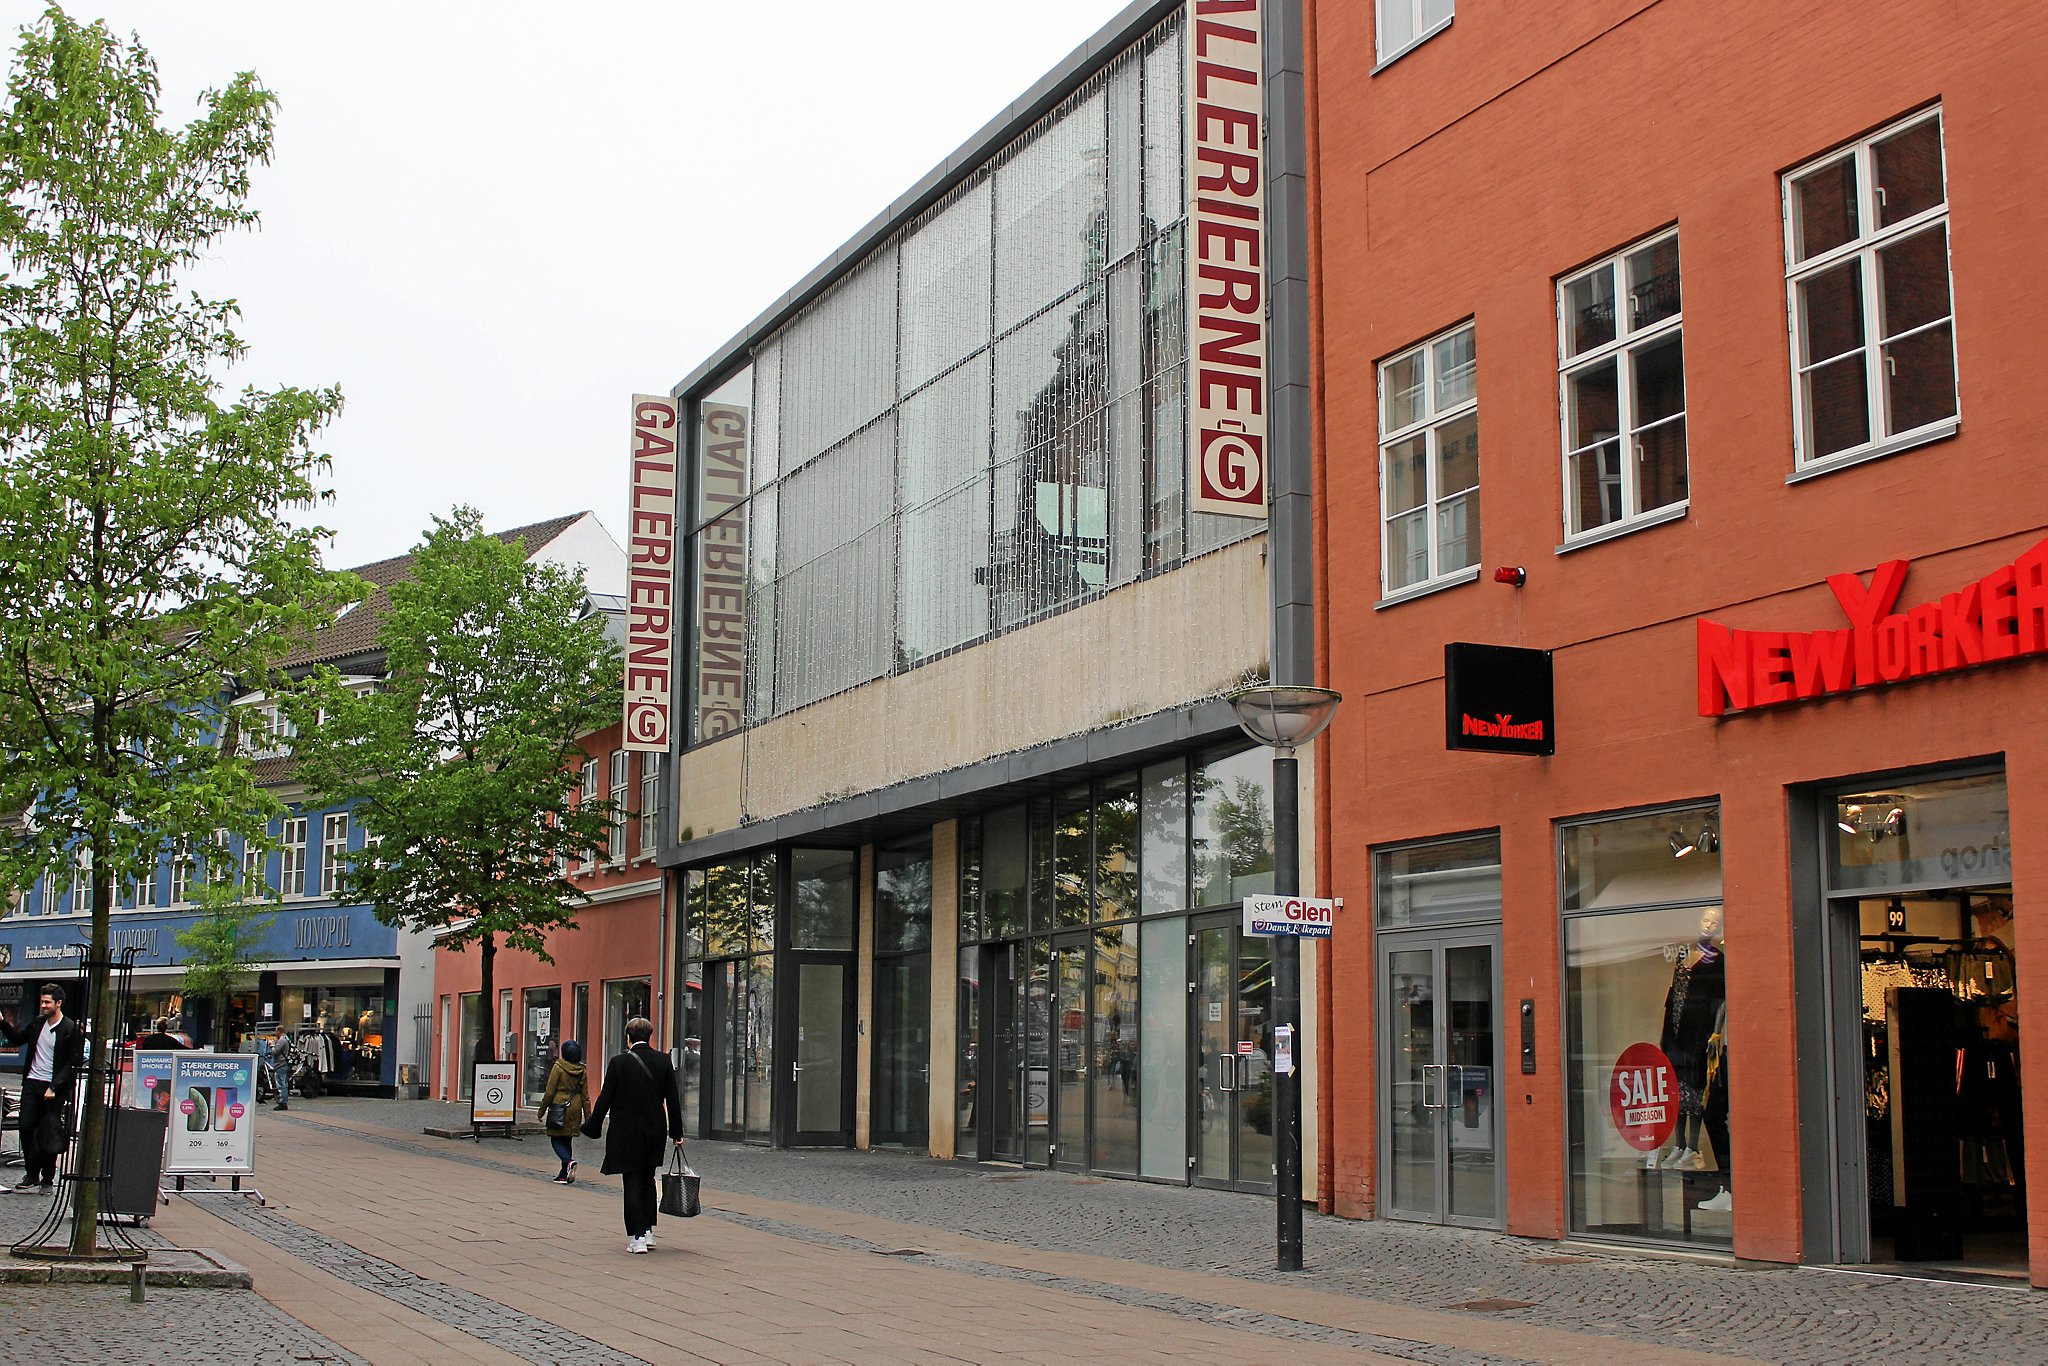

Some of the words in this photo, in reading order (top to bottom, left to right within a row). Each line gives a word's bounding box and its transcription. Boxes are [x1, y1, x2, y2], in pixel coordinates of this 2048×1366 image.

[628, 401, 676, 693] GALLERIERNE
[1285, 900, 1331, 921] Glen
[1889, 911, 1903, 926] 99
[295, 915, 351, 949] MONOPOL
[1265, 922, 1291, 932] Dansk
[112, 928, 159, 958] MONOPOL
[25, 946, 62, 961] Frederiksborg
[181, 1068, 191, 1077] PÅ
[192, 1070, 227, 1078] IPHONES
[213, 1062, 239, 1070] PRISER
[1618, 1066, 1669, 1107] SALE
[1629, 1110, 1663, 1123] MIDSEASON
